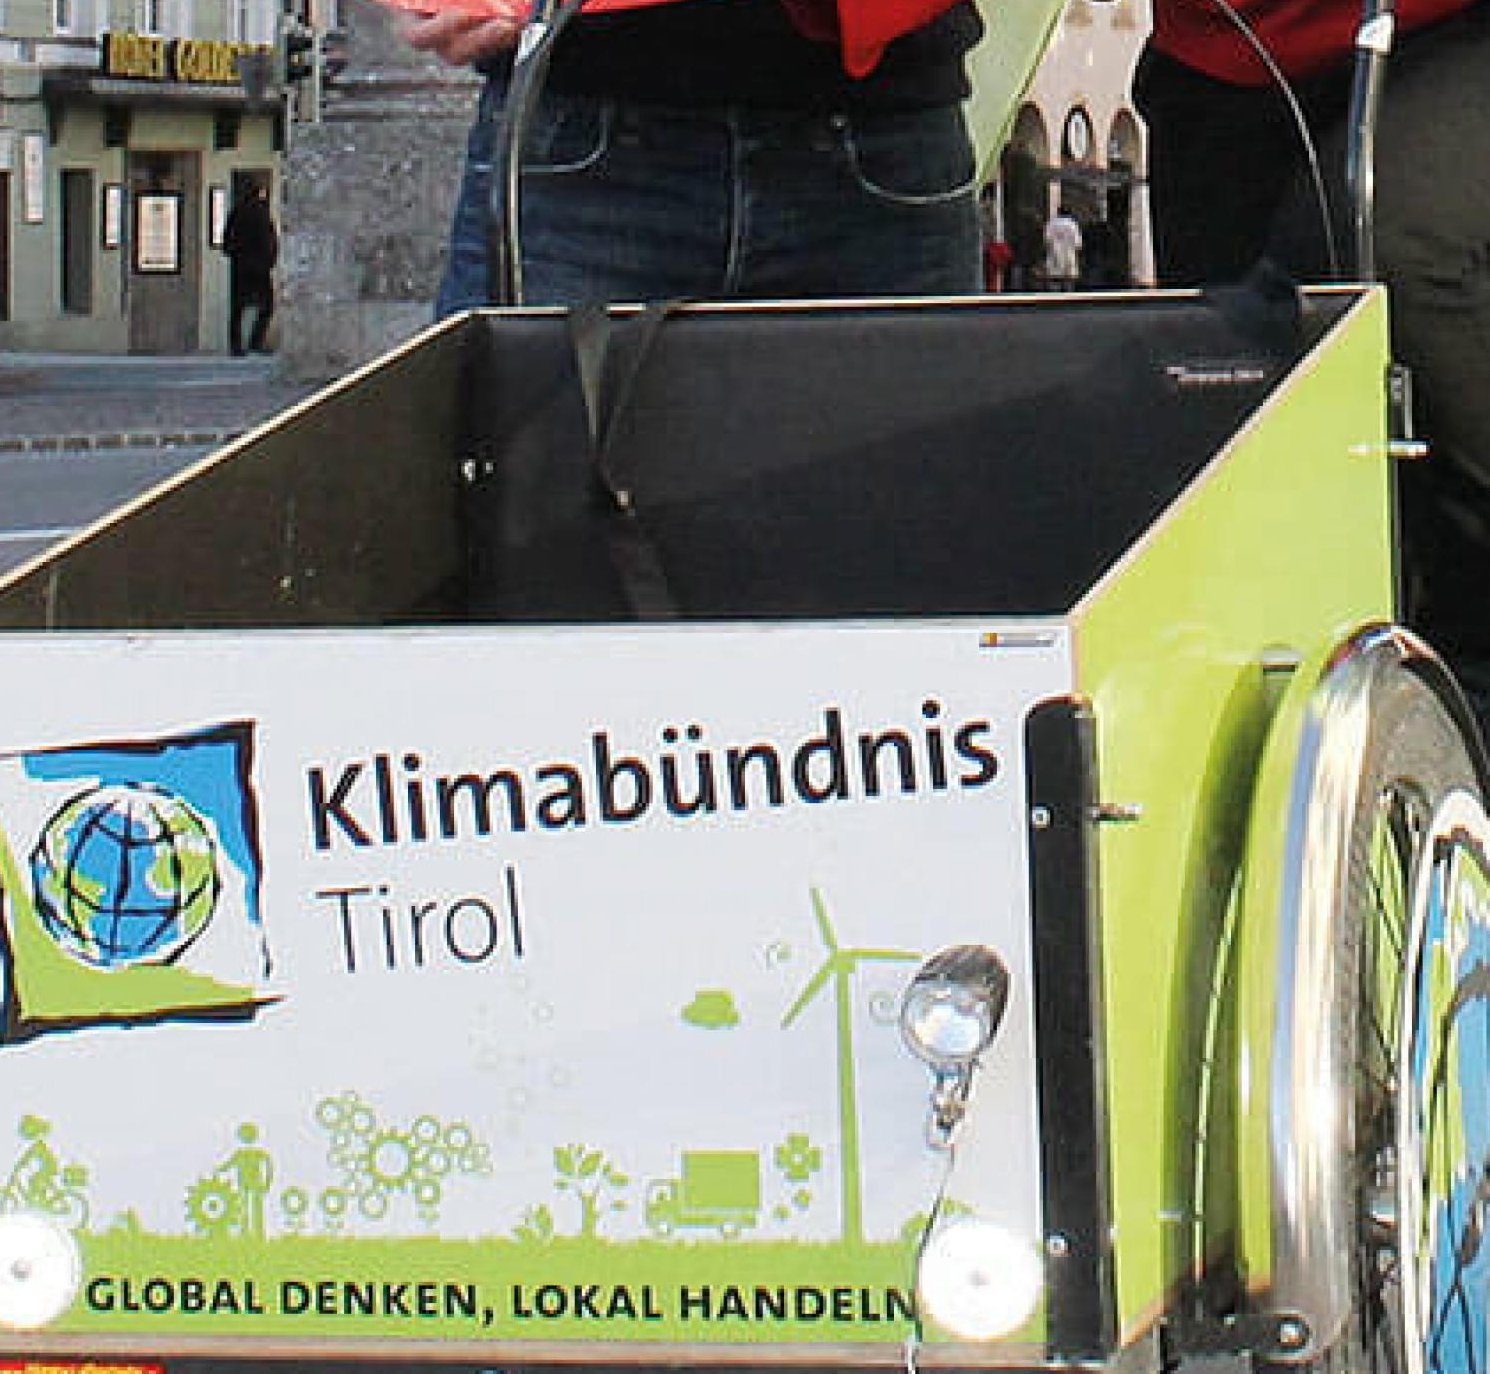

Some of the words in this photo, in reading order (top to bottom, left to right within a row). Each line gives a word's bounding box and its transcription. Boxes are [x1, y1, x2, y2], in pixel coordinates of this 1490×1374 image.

[306, 699, 1000, 852] Klimabündnis
[315, 866, 523, 974] Tirol
[85, 1277, 265, 1313] GLOBAL
[280, 1279, 495, 1328] DENKEN,
[511, 1283, 665, 1321] LOKAL
[679, 1284, 920, 1323] HANDELN
